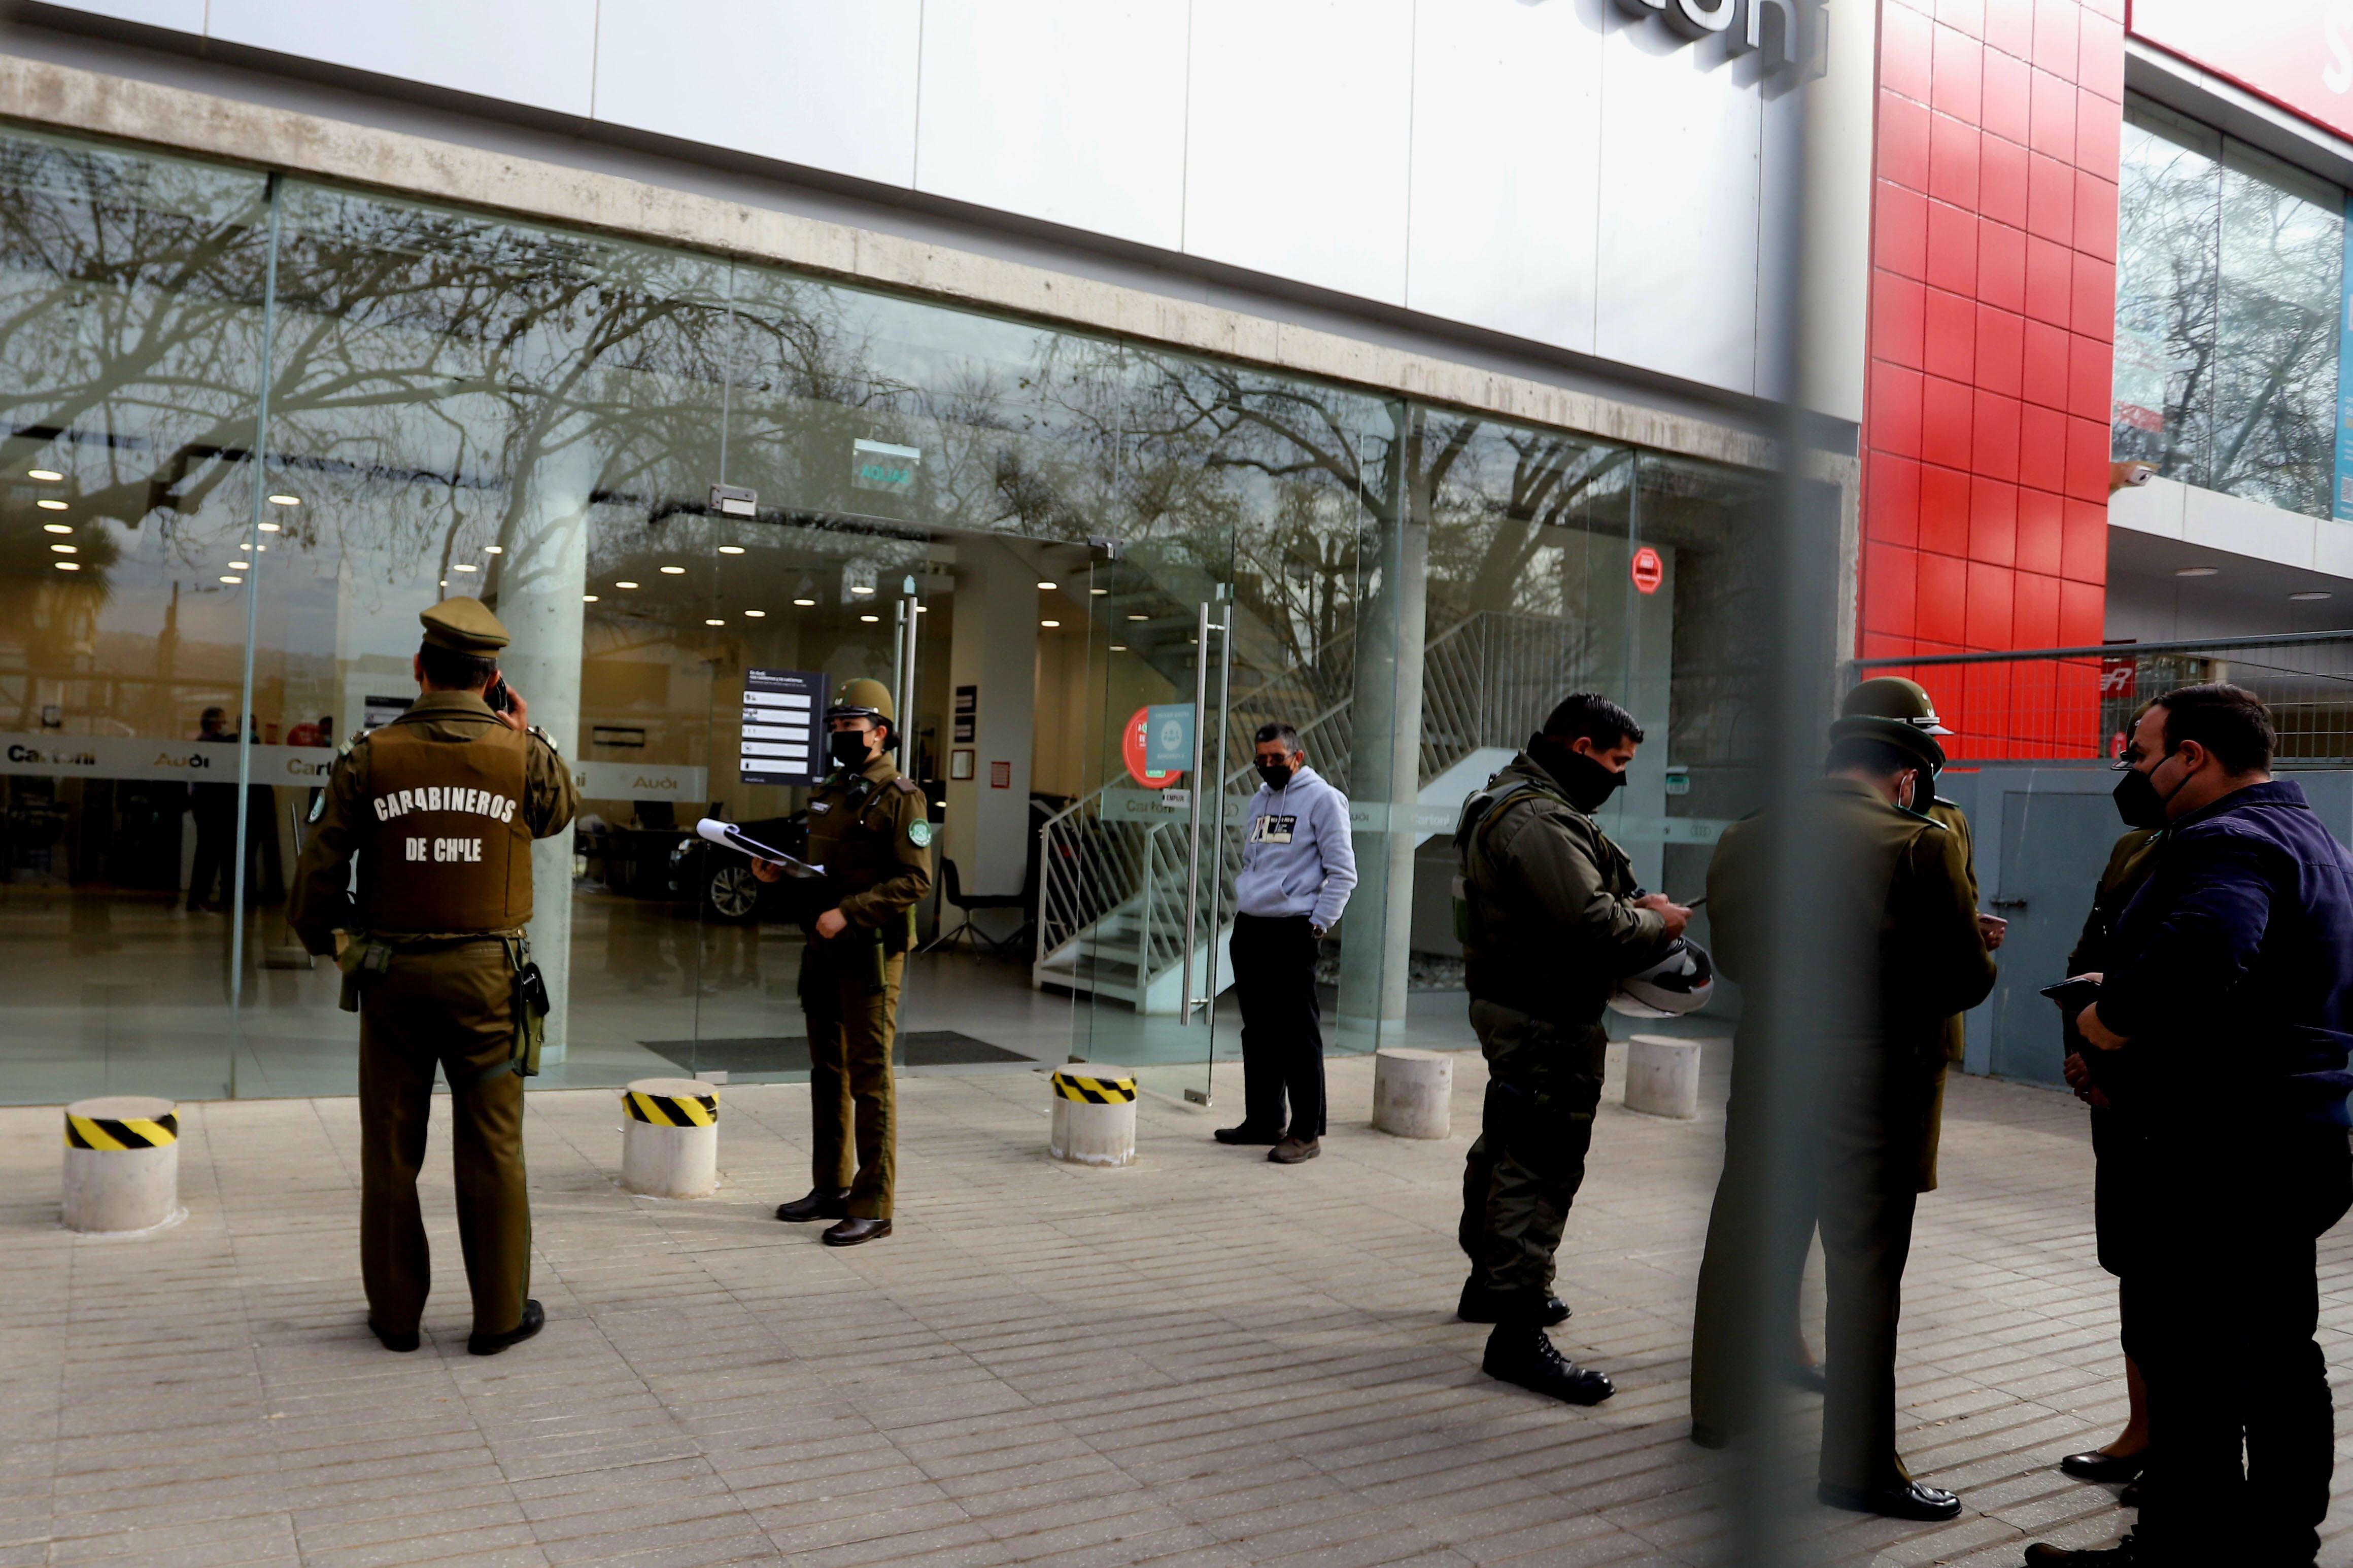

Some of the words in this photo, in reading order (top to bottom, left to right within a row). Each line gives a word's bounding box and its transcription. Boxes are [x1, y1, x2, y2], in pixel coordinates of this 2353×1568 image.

[154, 752, 209, 768] Audi
[632, 776, 677, 789] Audi
[373, 786, 517, 823] CARABINEROS
[406, 838, 427, 861] DE
[434, 838, 482, 862] CHILE
